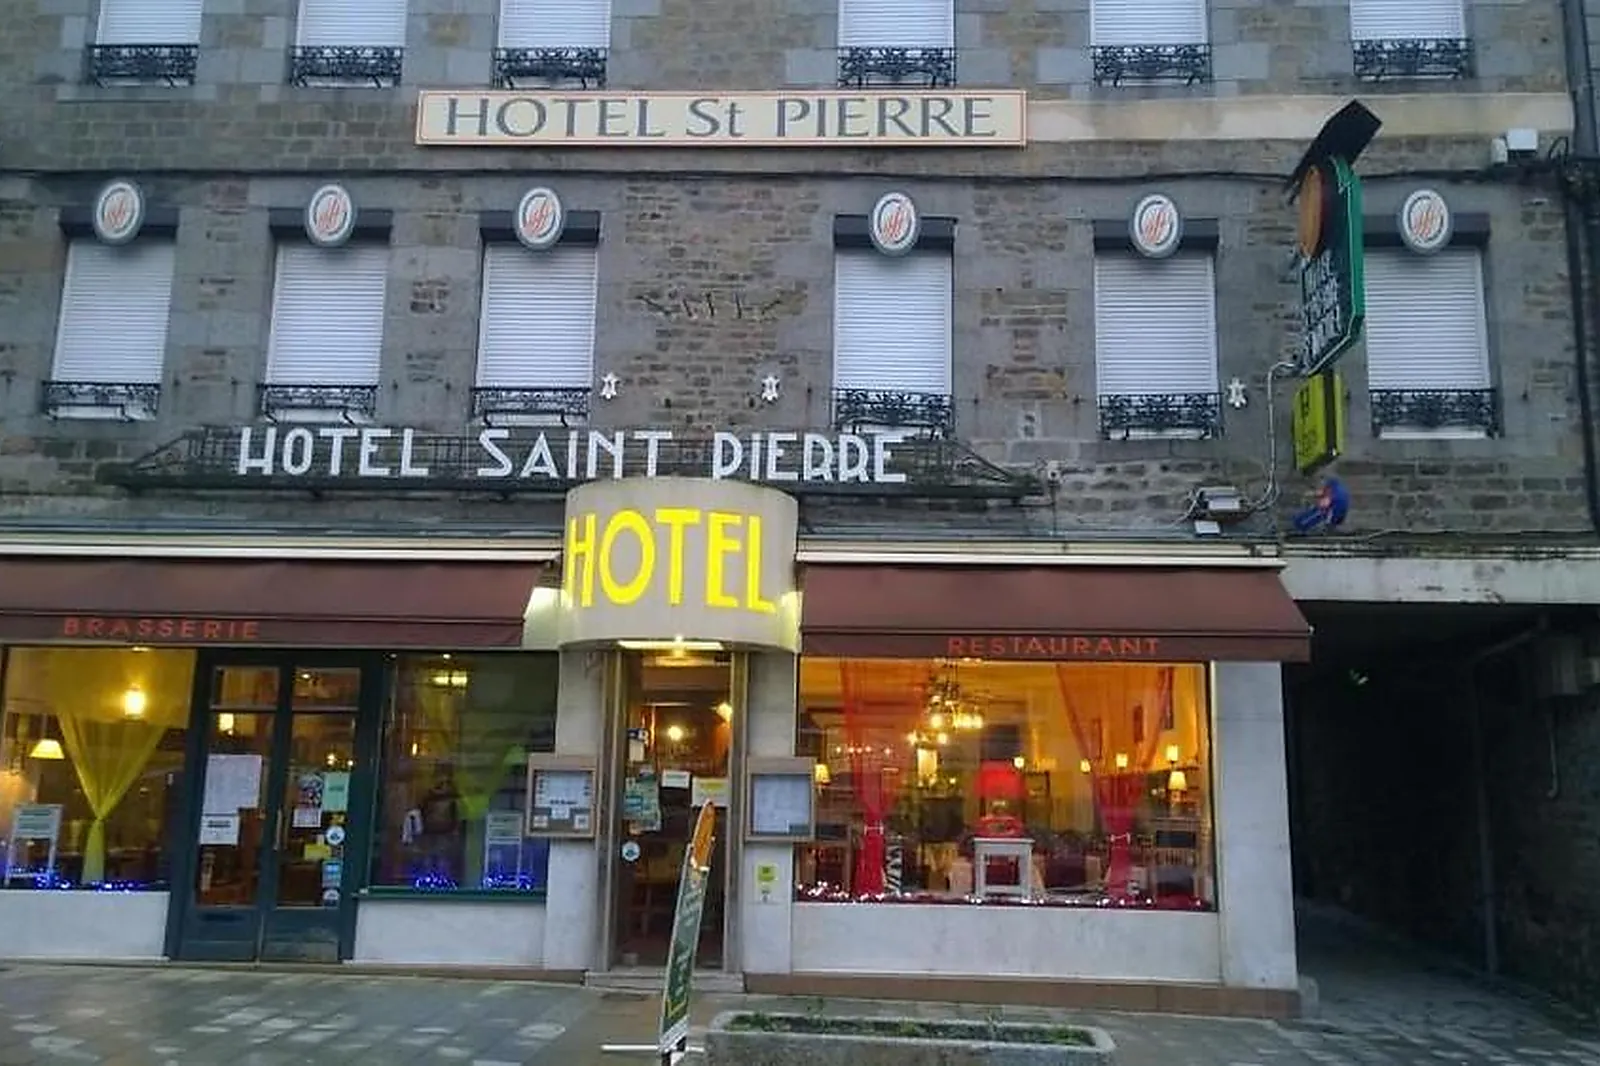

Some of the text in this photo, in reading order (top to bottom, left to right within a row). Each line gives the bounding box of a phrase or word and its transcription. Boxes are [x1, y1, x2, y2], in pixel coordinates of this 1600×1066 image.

[447, 97, 996, 138] HOTEL St PIERRE
[237, 427, 907, 483] HOTEL SAINT PIERRE
[564, 508, 777, 614] HOTEL
[63, 617, 260, 639] BRASSERIE
[947, 636, 1160, 656] RESTAURANT
